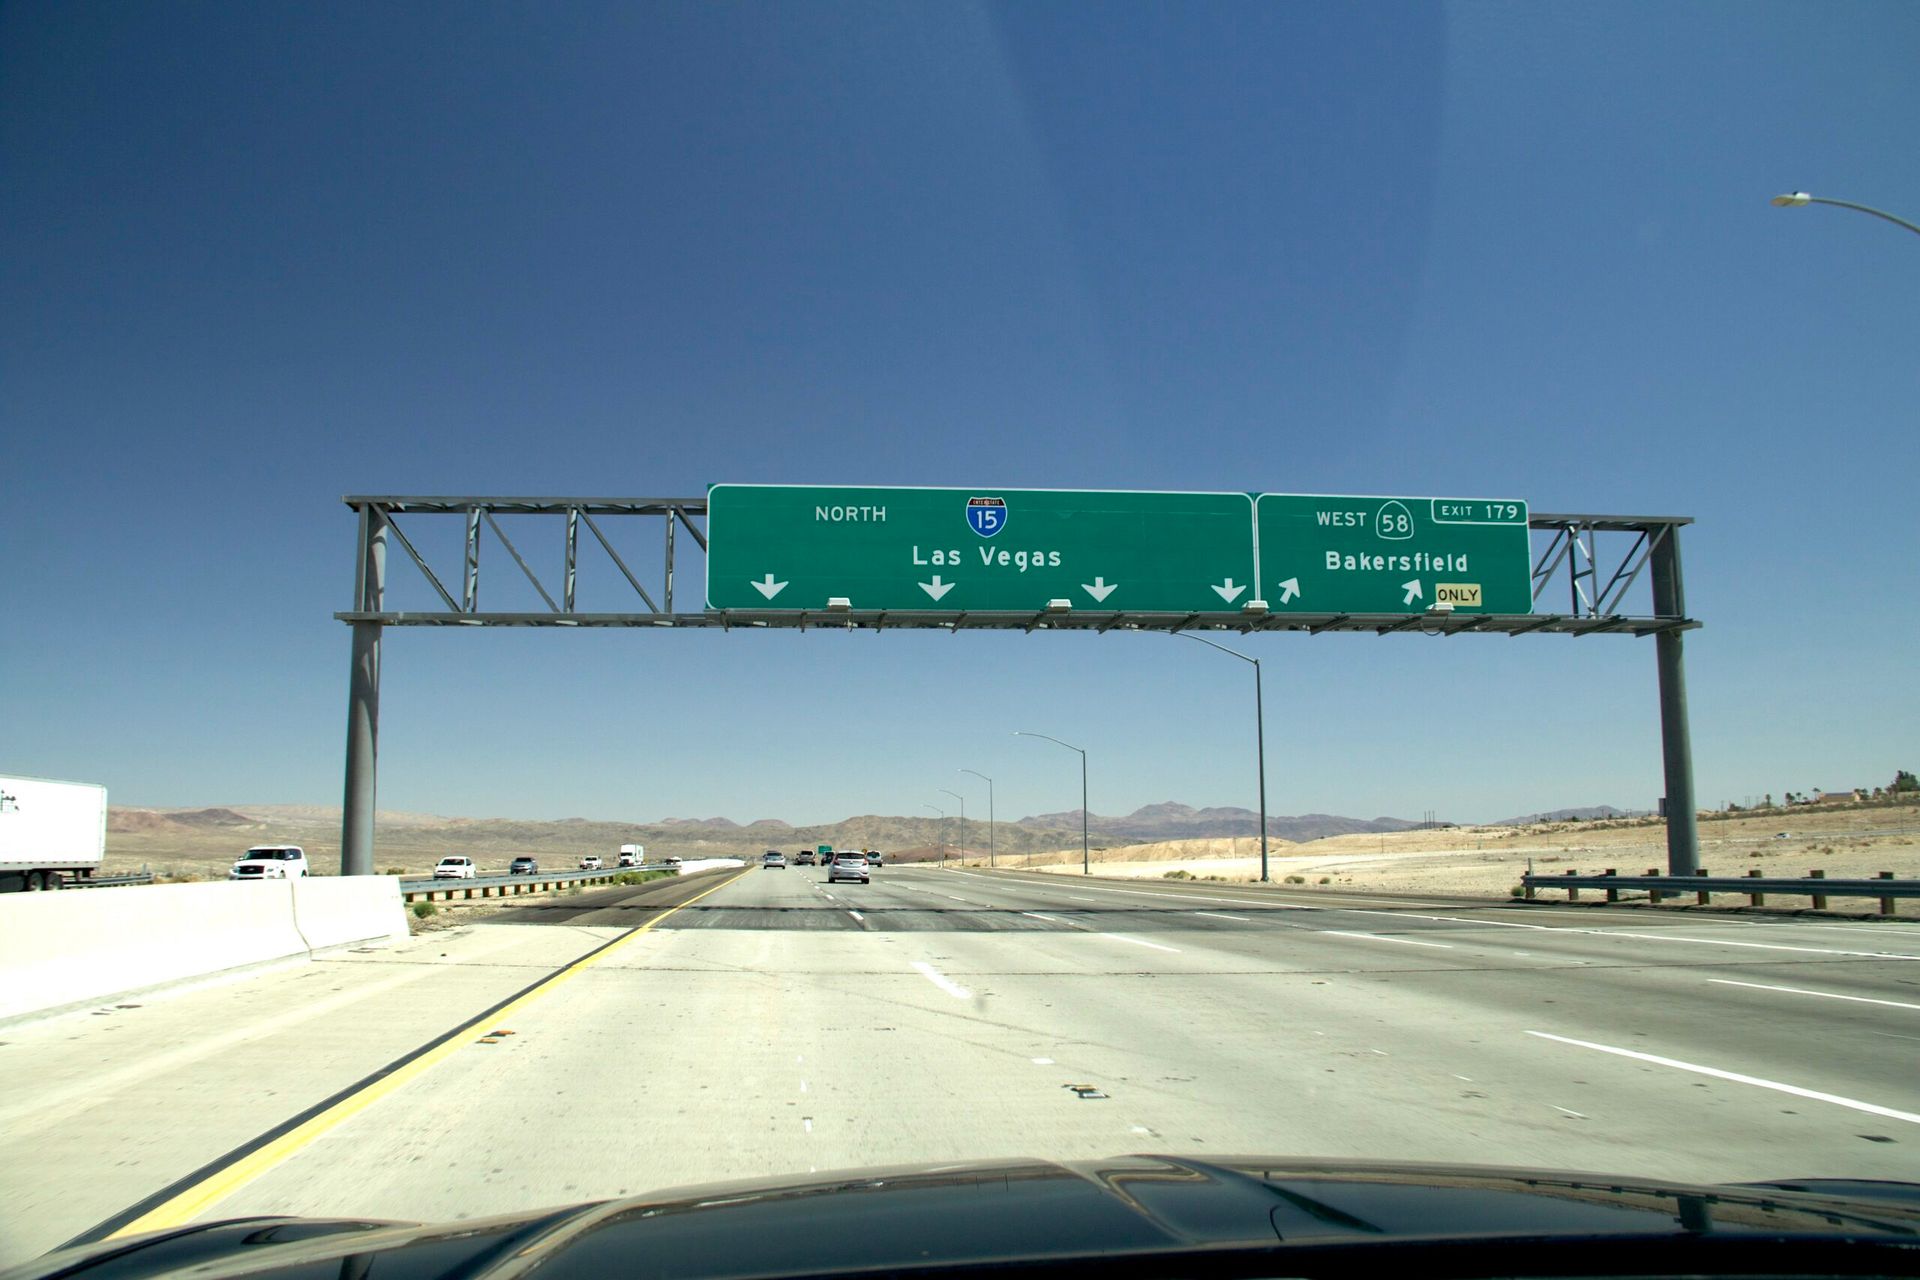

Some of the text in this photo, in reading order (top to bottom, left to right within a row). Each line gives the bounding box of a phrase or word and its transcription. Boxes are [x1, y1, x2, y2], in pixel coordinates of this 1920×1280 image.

[815, 505, 886, 522] NORTH
[976, 510, 998, 529] 15
[1316, 511, 1367, 527] WEST
[1441, 504, 1518, 519] EXIT 179
[1381, 515, 1409, 532] 58
[912, 545, 1062, 573] Las Vegas
[1325, 551, 1468, 572] Bakersfield
[1438, 588, 1478, 602] ONLY
